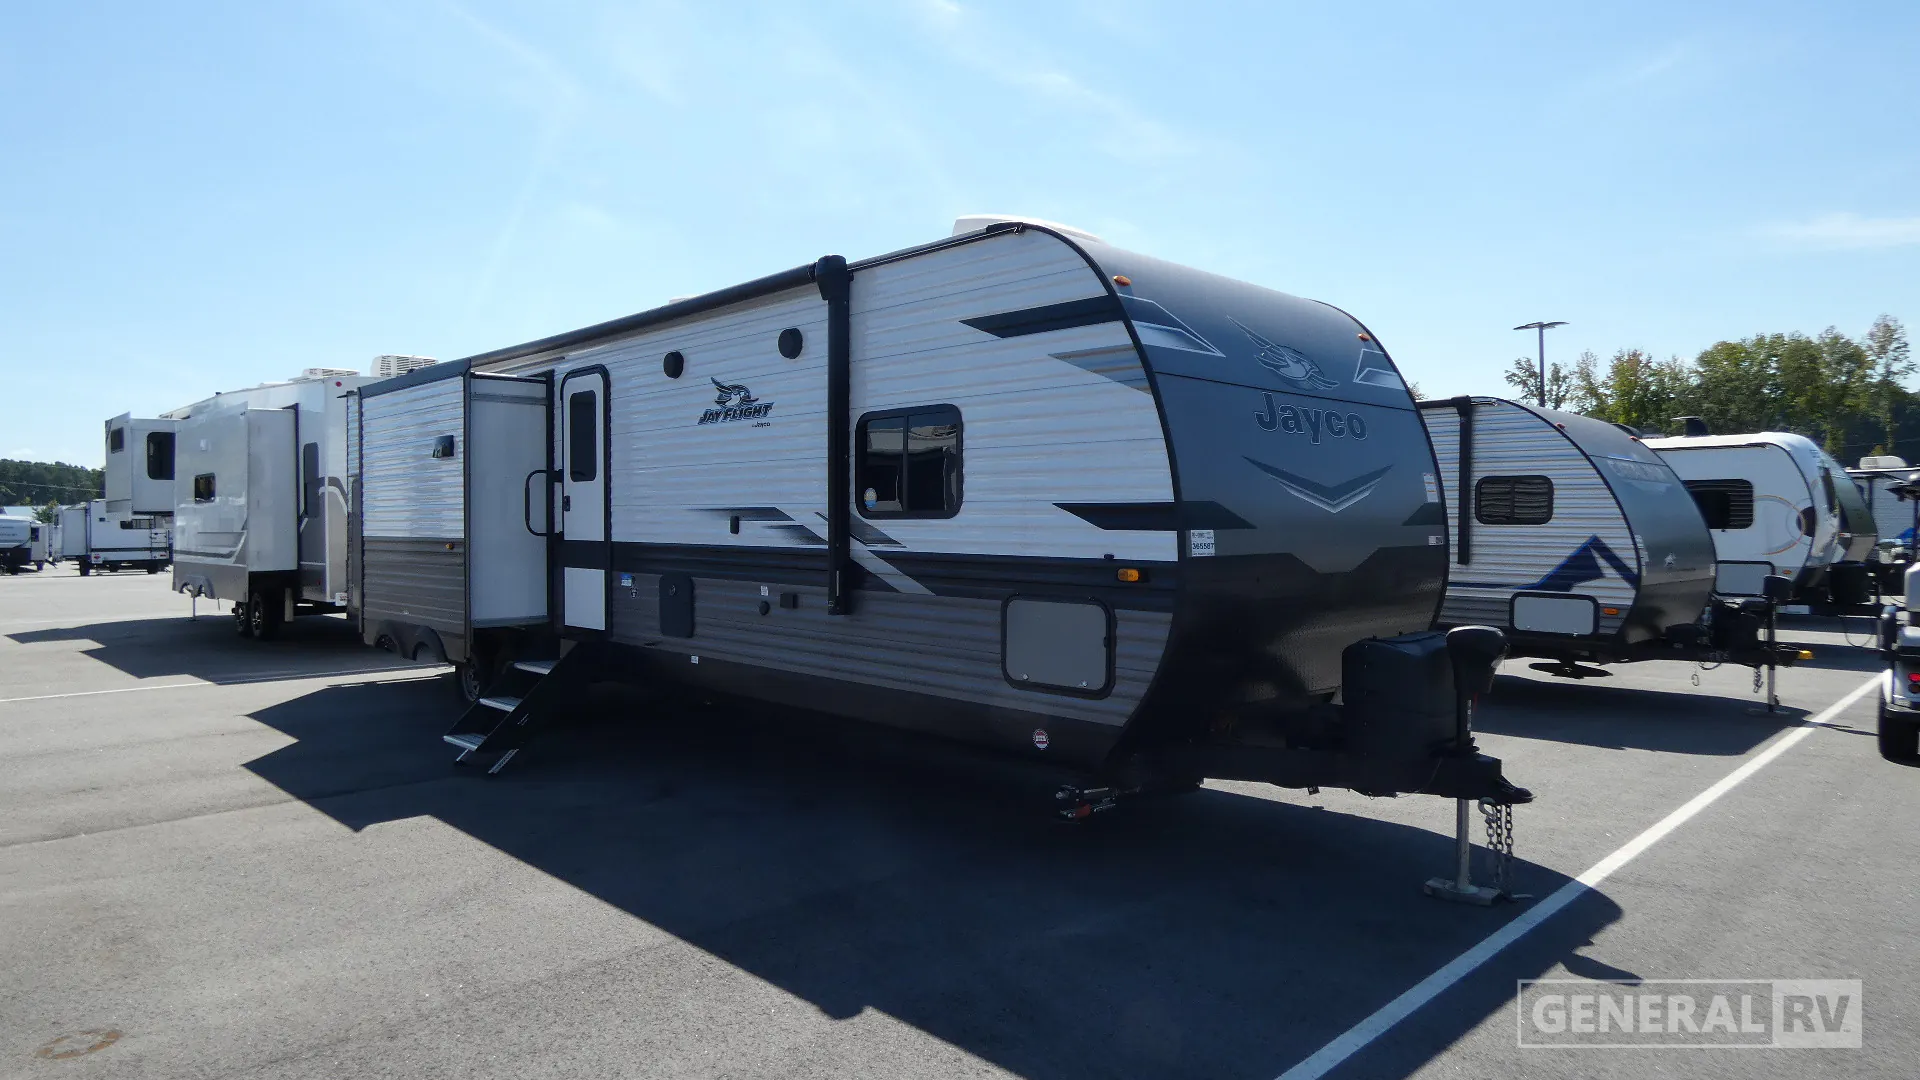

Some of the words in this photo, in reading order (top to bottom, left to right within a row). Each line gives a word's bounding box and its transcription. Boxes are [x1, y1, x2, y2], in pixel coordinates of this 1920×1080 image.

[698, 408, 723, 425] JAY
[722, 402, 775, 420] FLIGHT
[1254, 391, 1368, 445] Jayco
